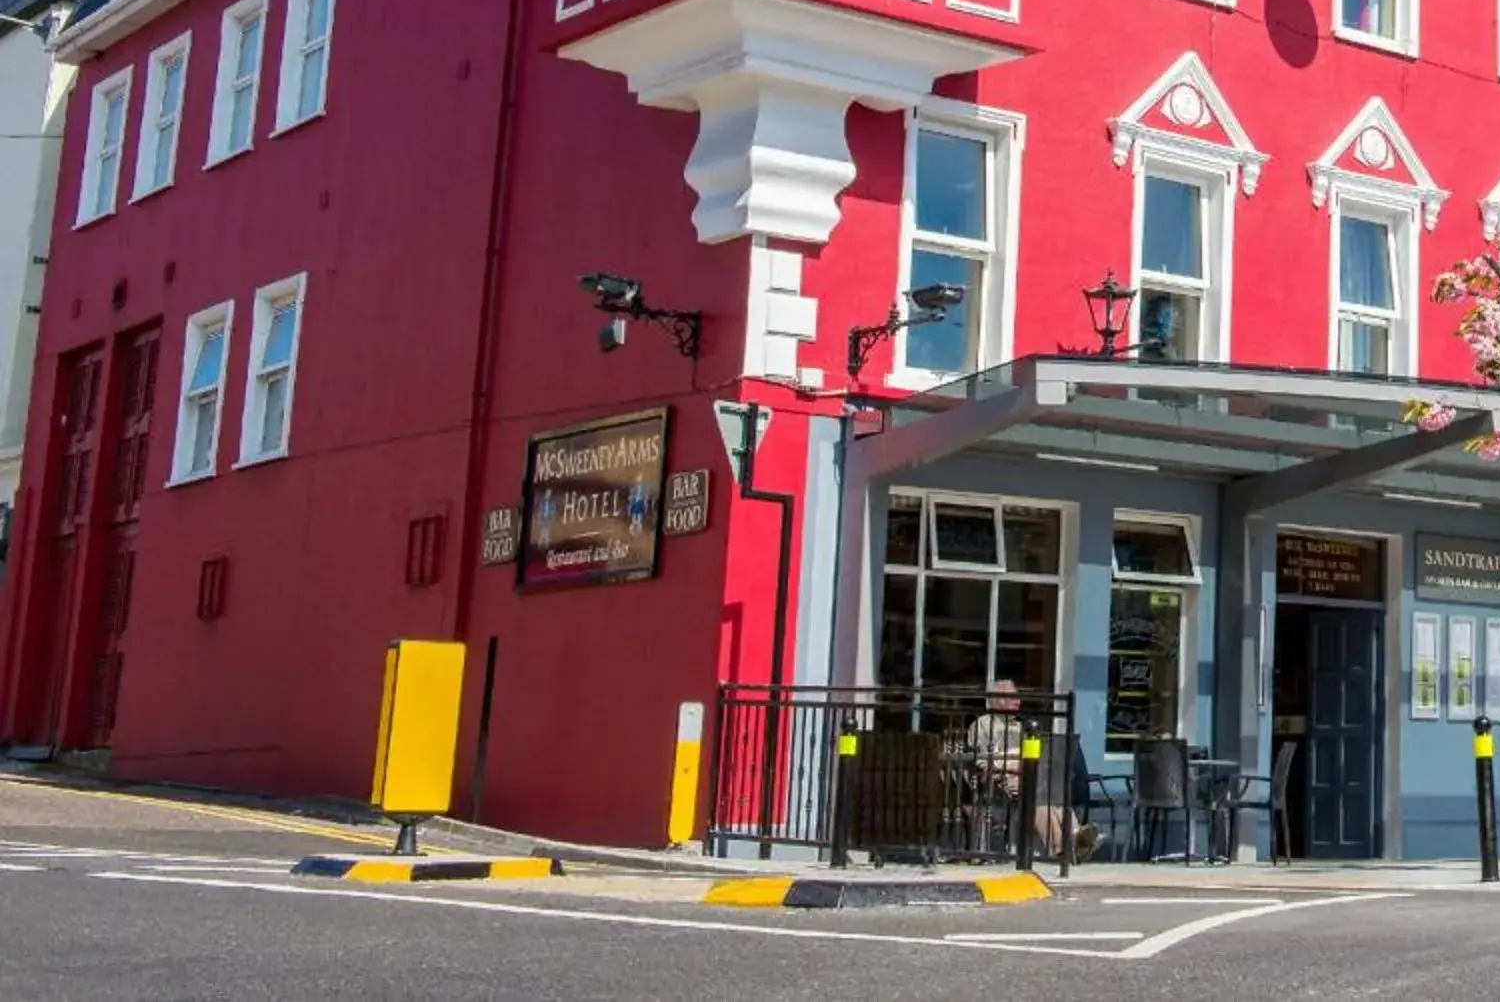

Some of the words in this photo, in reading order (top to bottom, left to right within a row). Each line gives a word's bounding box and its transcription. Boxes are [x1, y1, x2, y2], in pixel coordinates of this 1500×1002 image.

[614, 435, 660, 468] ARMS
[673, 474, 699, 499] BAR
[563, 490, 620, 525] HOTEL
[667, 506, 701, 531] FOOD
[490, 509, 511, 533] BAR
